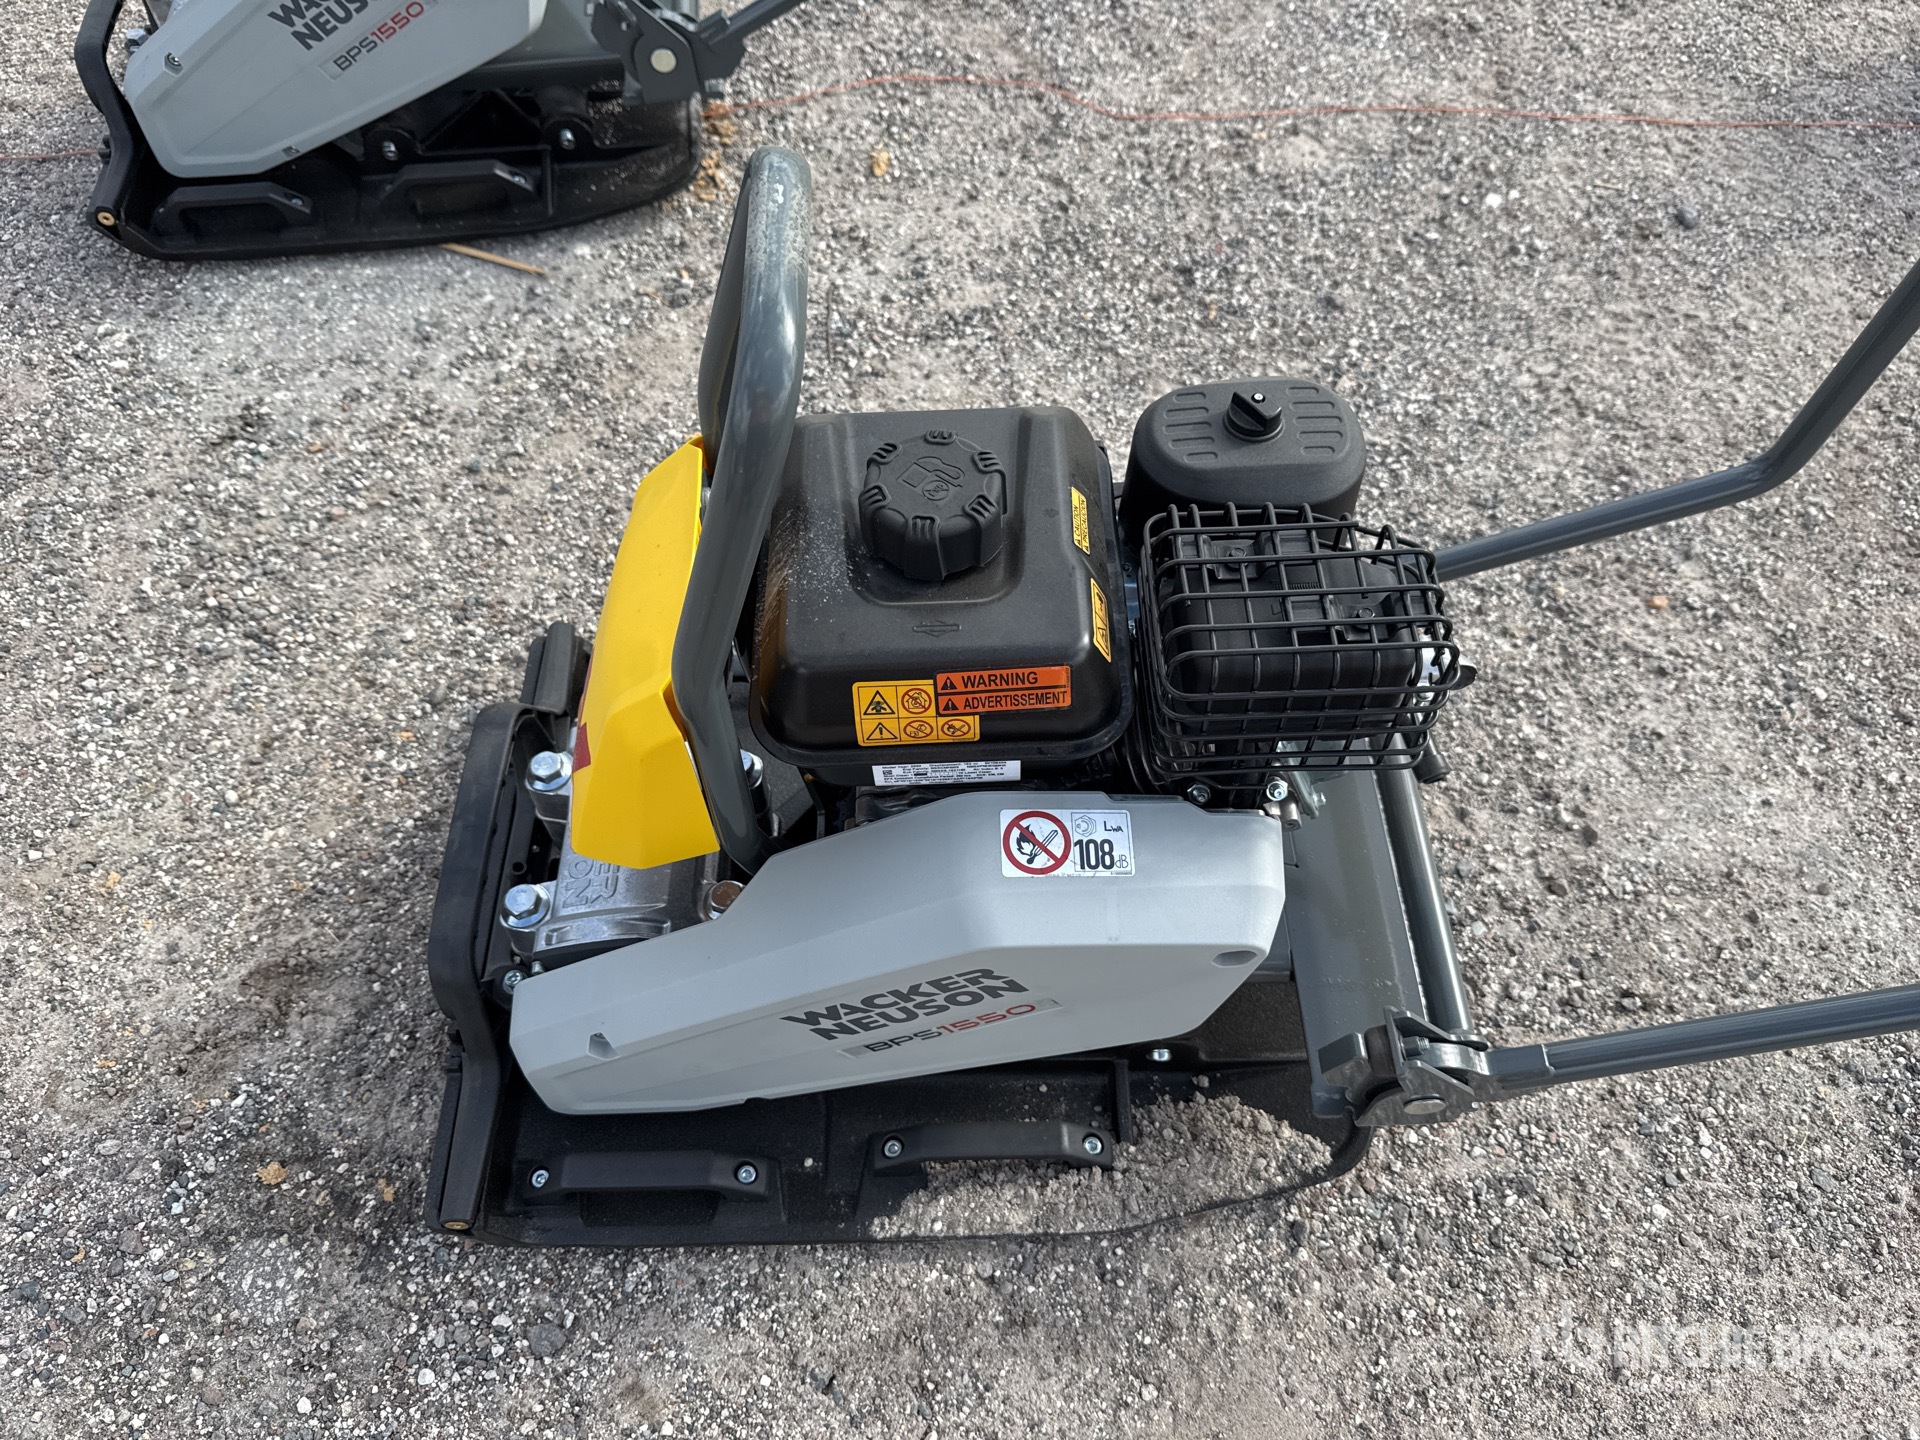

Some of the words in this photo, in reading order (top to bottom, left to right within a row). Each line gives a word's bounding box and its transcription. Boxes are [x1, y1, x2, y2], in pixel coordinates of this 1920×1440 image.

[291, 0, 370, 51] NEUS
[333, 1, 425, 72] BPS1550
[961, 671, 1039, 689] WARNING
[963, 690, 1068, 710] ADVERTISSEMENT
[1074, 839, 1115, 870] 108
[1115, 854, 1129, 869] dB
[779, 968, 1010, 1026] WACKER
[809, 979, 1030, 1041] NEUSON
[864, 1004, 1037, 1052] BPS1550
